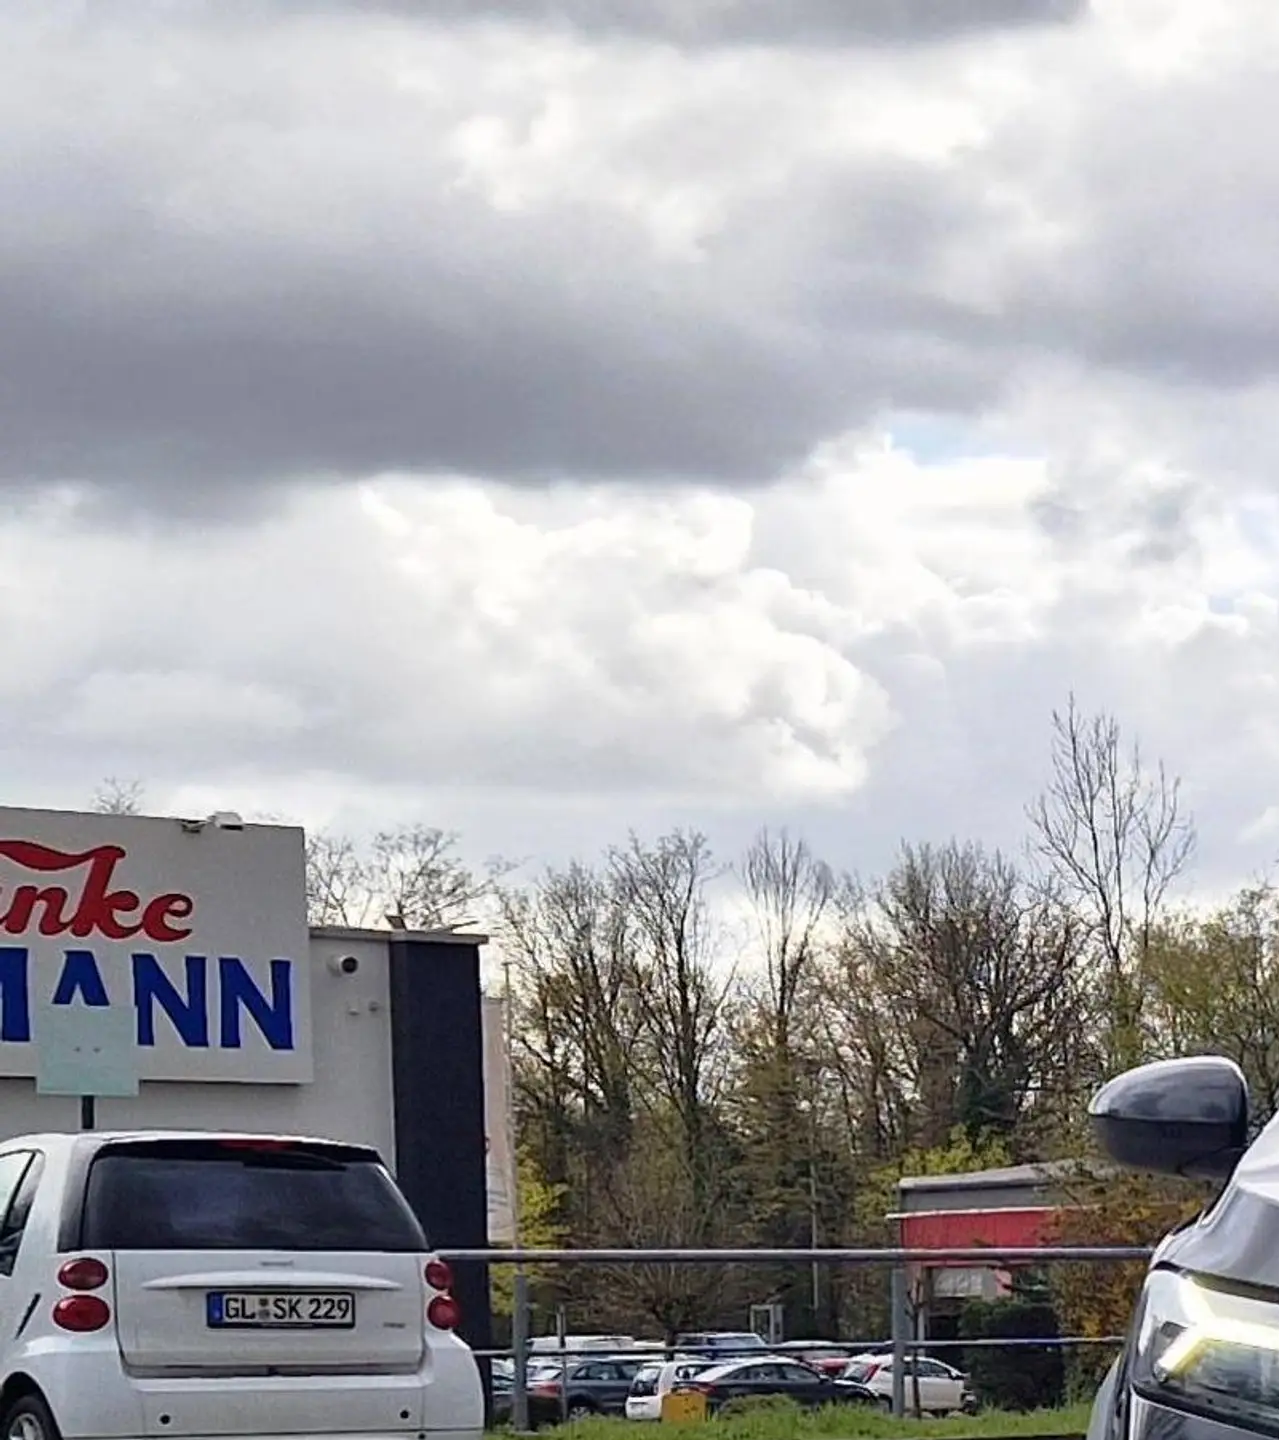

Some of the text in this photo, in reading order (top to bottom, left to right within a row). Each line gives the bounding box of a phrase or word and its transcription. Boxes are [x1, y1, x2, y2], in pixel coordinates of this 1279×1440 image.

[0, 840, 193, 942] nke
[225, 1298, 350, 1320] GL SK 229
